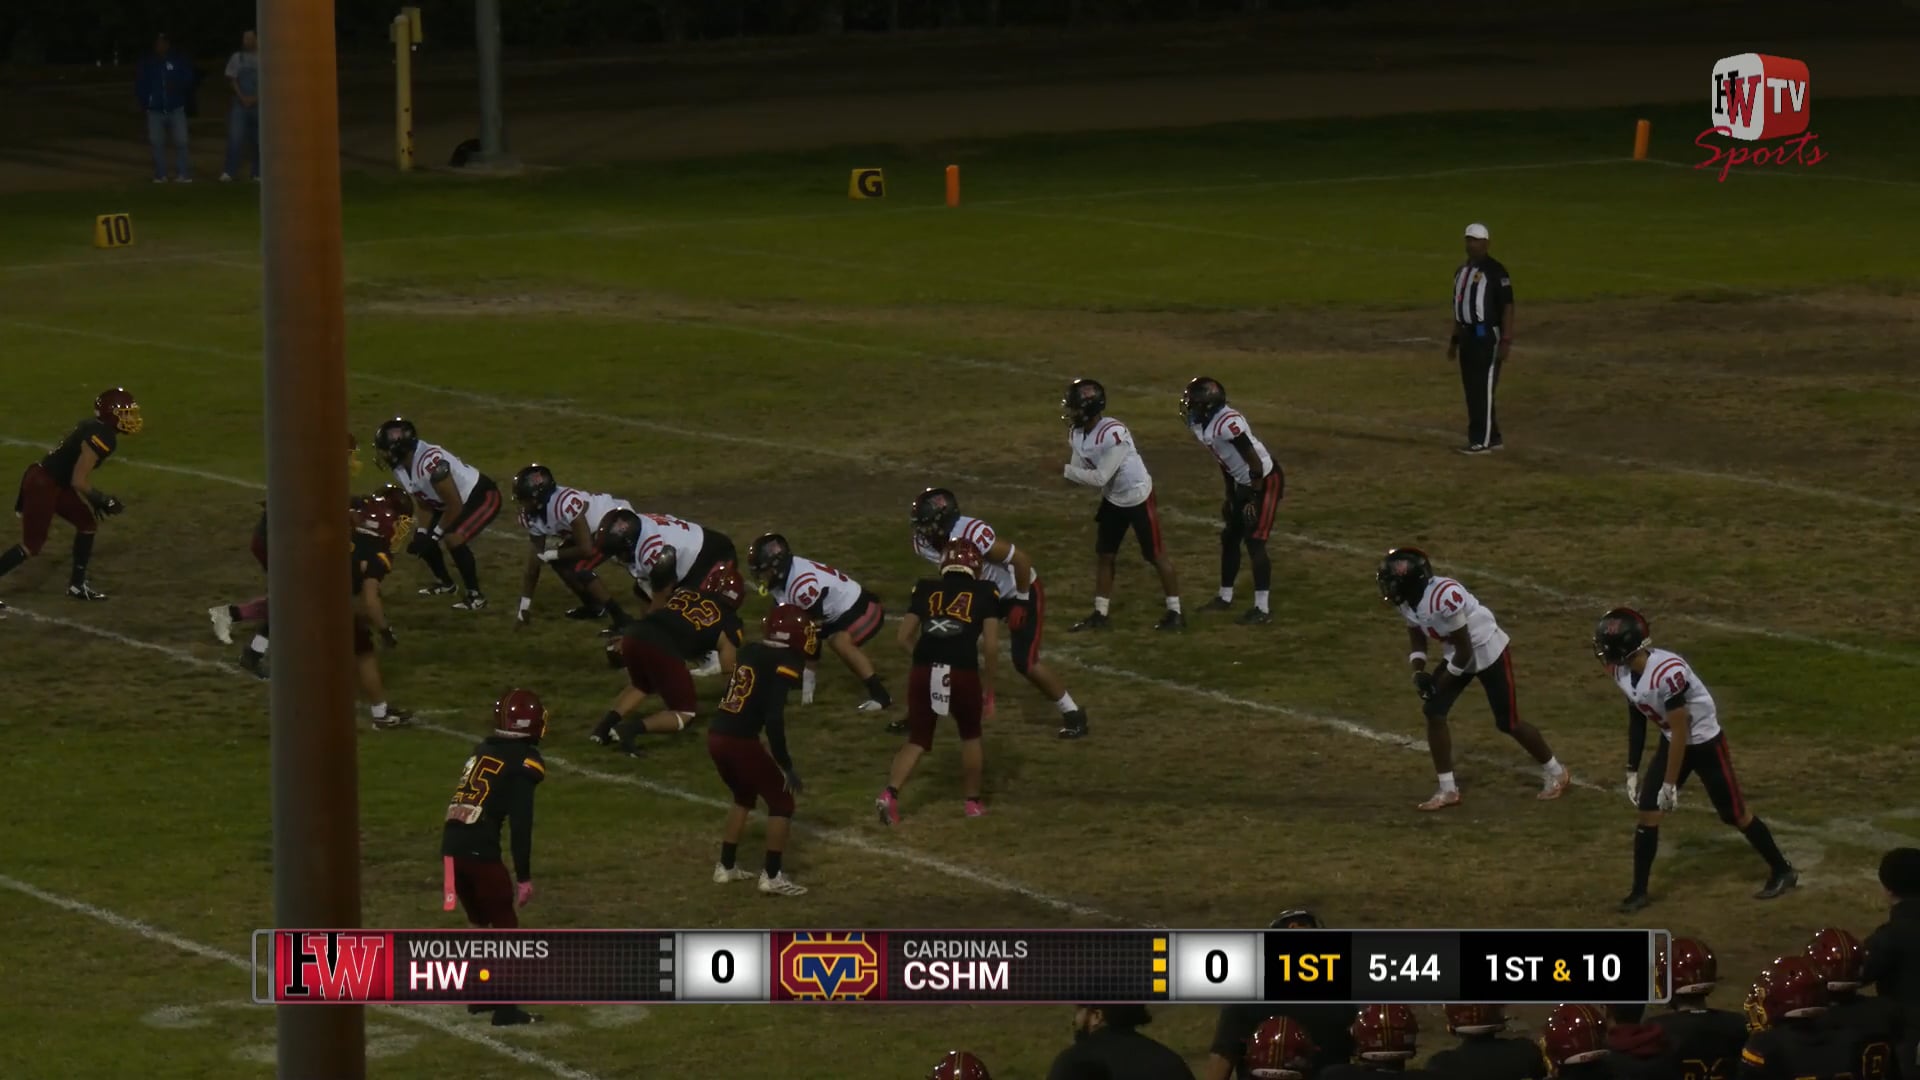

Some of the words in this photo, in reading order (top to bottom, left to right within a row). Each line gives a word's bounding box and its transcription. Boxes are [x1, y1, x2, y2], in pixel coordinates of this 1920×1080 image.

[858, 170, 882, 197] G
[102, 215, 131, 245] 10
[1112, 432, 1122, 445] 1
[565, 497, 583, 518] 73
[975, 527, 995, 549] 79
[928, 590, 974, 624] 14
[1444, 590, 1464, 613] 14
[1665, 671, 1686, 694] 12
